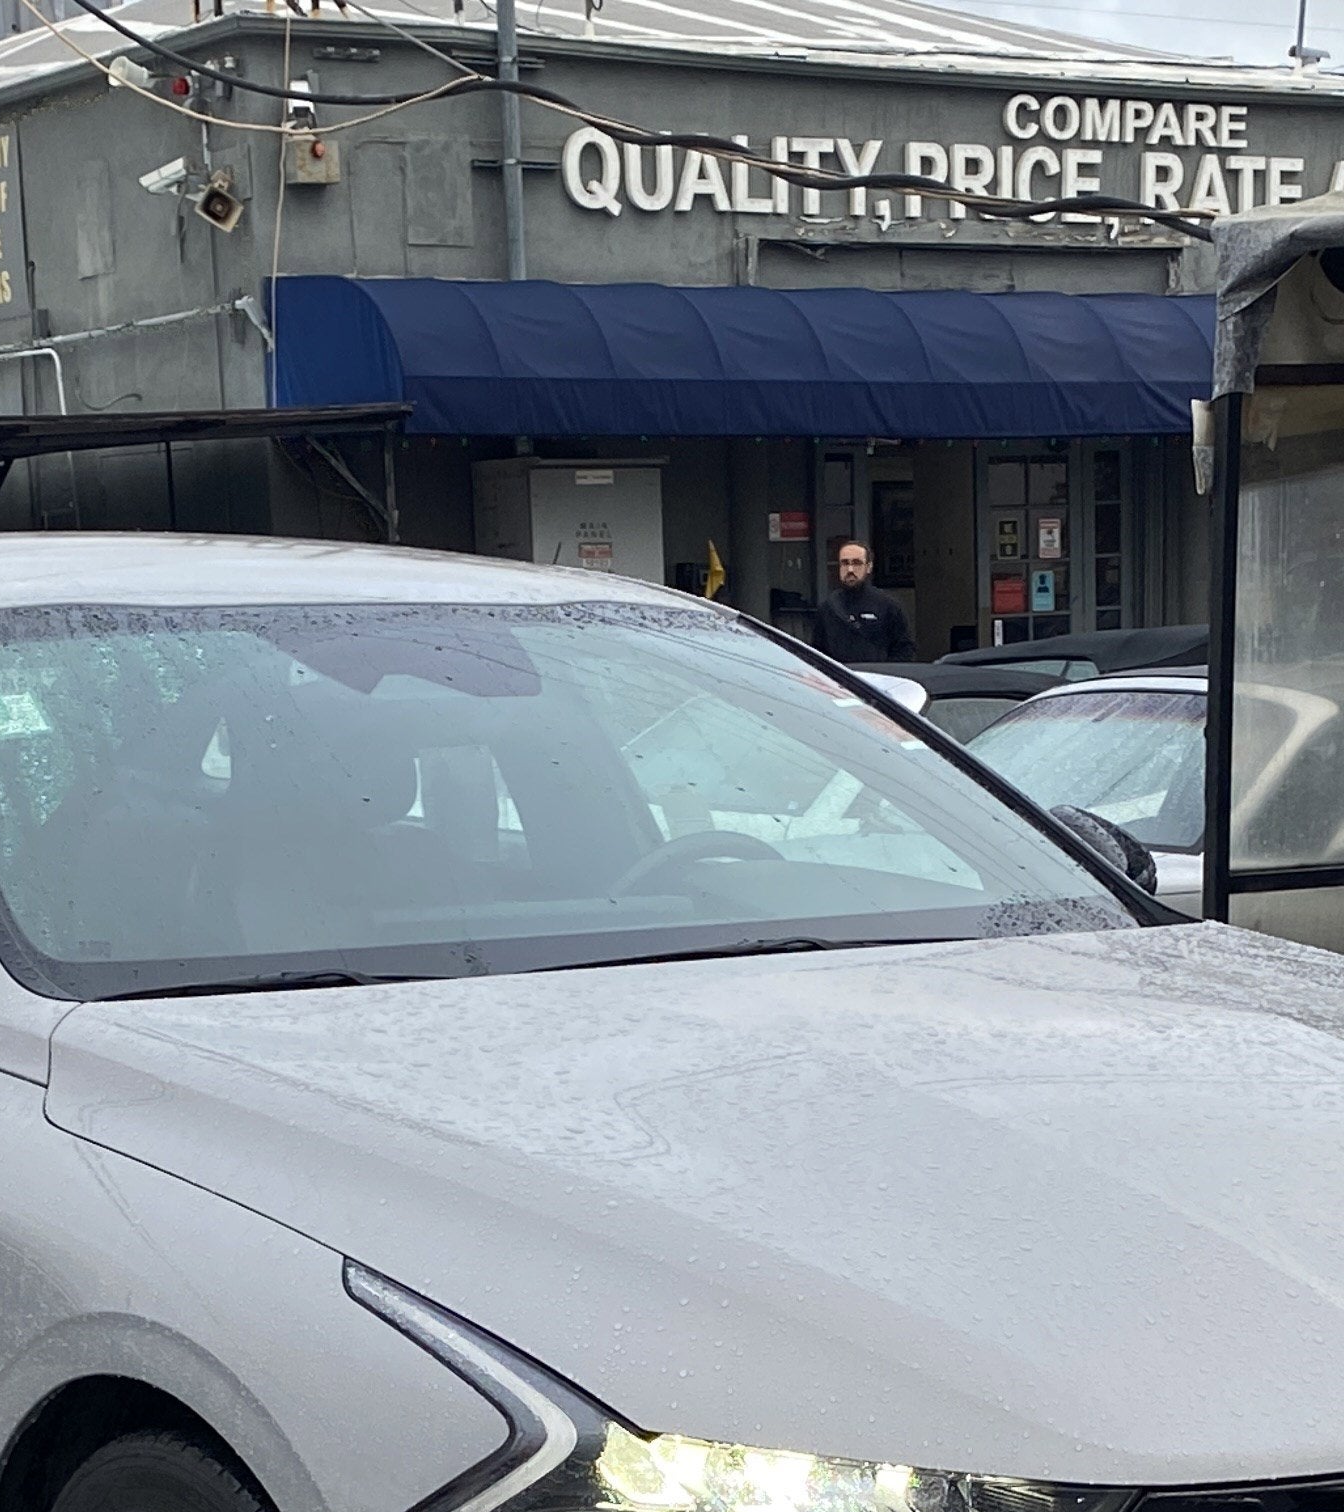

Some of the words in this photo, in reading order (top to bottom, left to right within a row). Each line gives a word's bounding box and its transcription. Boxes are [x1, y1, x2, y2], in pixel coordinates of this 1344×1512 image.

[1004, 94, 1248, 148] COMPARE
[561, 126, 892, 232] QUALITY,
[904, 141, 1120, 240] PRICE,
[1140, 151, 1304, 225] RATE
